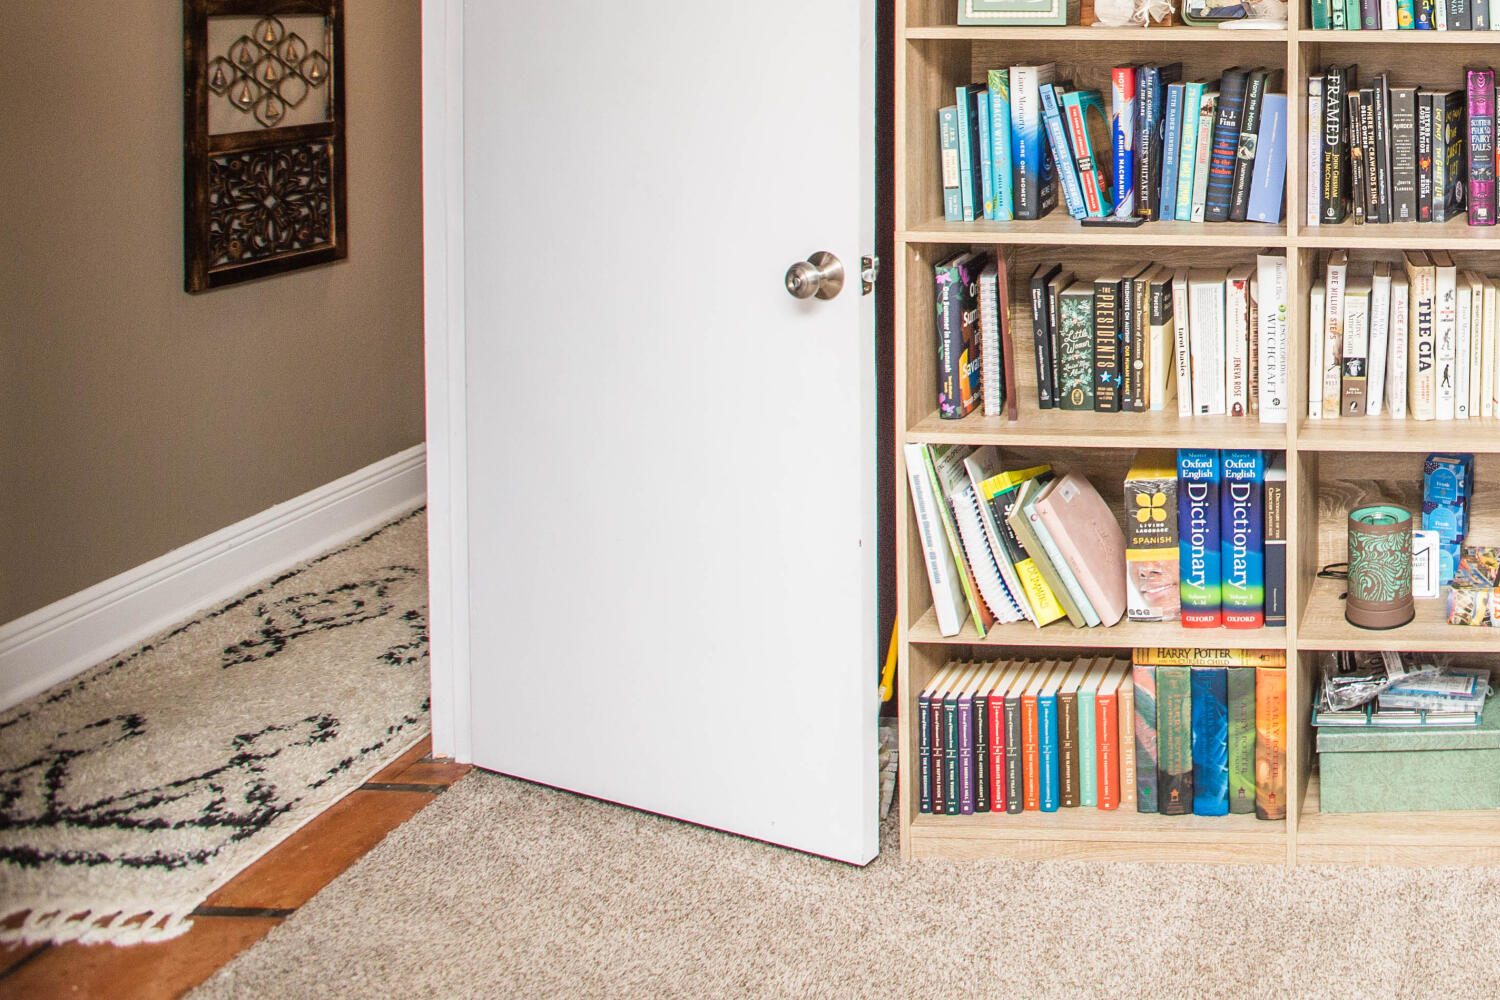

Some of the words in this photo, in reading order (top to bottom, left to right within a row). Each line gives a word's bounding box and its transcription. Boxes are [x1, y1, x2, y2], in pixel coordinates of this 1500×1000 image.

[1018, 71, 1028, 95] Liane
[1018, 96, 1028, 132] Moriarty
[1219, 117, 1236, 127] Finn
[1327, 74, 1341, 146] FRAMED
[1366, 104, 1374, 129] WHERE
[1118, 134, 1126, 157] ANNIE
[1142, 129, 1151, 158] CHRIS
[1367, 131, 1375, 145] THE
[1368, 147, 1377, 182] CRAWDADS
[1118, 158, 1126, 200] MACMANUS
[1140, 161, 1149, 202] WHITAKER
[1330, 270, 1339, 285] ONE
[1152, 292, 1161, 317] Foucault
[1329, 287, 1338, 316] MILLION
[1396, 300, 1405, 325] ALICE
[1328, 317, 1338, 340] STEPS
[1418, 298, 1432, 338] THE
[1096, 294, 1115, 368] PRESIDENTS
[1177, 327, 1187, 348] tarot
[1347, 312, 1357, 355] Americans
[1266, 313, 1277, 395] WITCHCRAFT
[1396, 327, 1404, 360] FEENEY
[1179, 350, 1188, 377] basics
[1233, 357, 1242, 380] JENEVA
[1418, 341, 1432, 373] CIA
[1233, 381, 1242, 398] ROSE
[1181, 459, 1213, 469] Oxford
[1182, 469, 1213, 481] English
[1224, 459, 1256, 469] Oxford
[1224, 469, 1256, 481] English
[1131, 536, 1173, 546] SPANISH
[1186, 482, 1210, 591] Dictionary
[1228, 482, 1252, 592] Dictionary
[1185, 615, 1214, 623] OXFORD
[1226, 615, 1255, 623] OXFORD
[1157, 648, 1191, 659] HARRY
[1193, 648, 1232, 660] POTTER
[1125, 749, 1134, 766] THE
[1125, 767, 1134, 785] END
